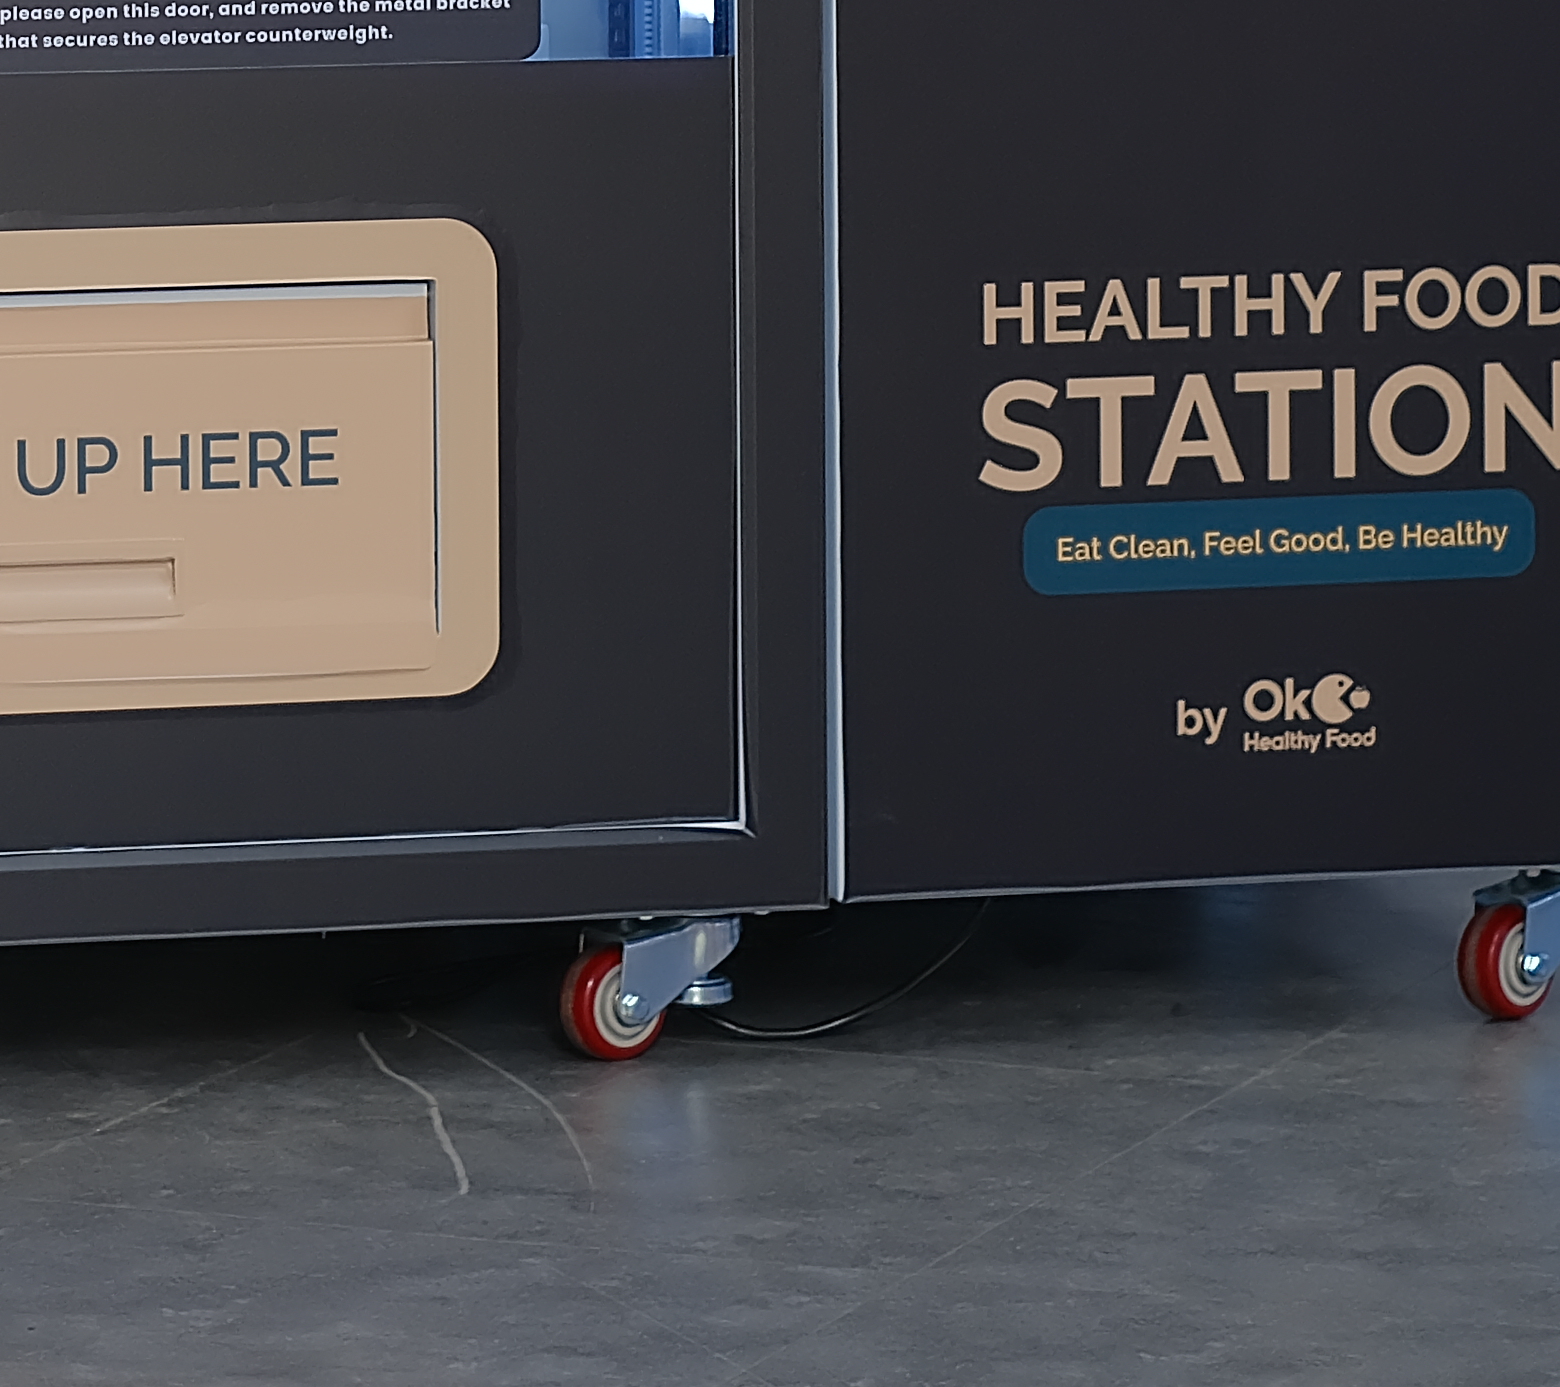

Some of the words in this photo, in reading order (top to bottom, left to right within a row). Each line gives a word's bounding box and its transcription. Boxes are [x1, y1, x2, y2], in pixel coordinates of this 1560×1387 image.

[0, 5, 65, 26] please
[69, 6, 118, 24] open
[123, 2, 160, 19] this
[164, 2, 214, 20] door,
[218, 0, 256, 16] and
[260, 1, 334, 15] remove
[982, 270, 1342, 346] HEALTHY
[16, 436, 119, 497] UP
[143, 428, 339, 493] HERE
[1056, 536, 1103, 562] Eat
[1108, 533, 1196, 560] Clean,
[1204, 528, 1265, 556] Feel
[1269, 525, 1350, 553] Good,
[1358, 525, 1395, 550] Be
[1402, 519, 1509, 552] Healthy
[1176, 699, 1228, 745] by
[1243, 729, 1322, 754] Healthy
[1325, 725, 1377, 749] Food
